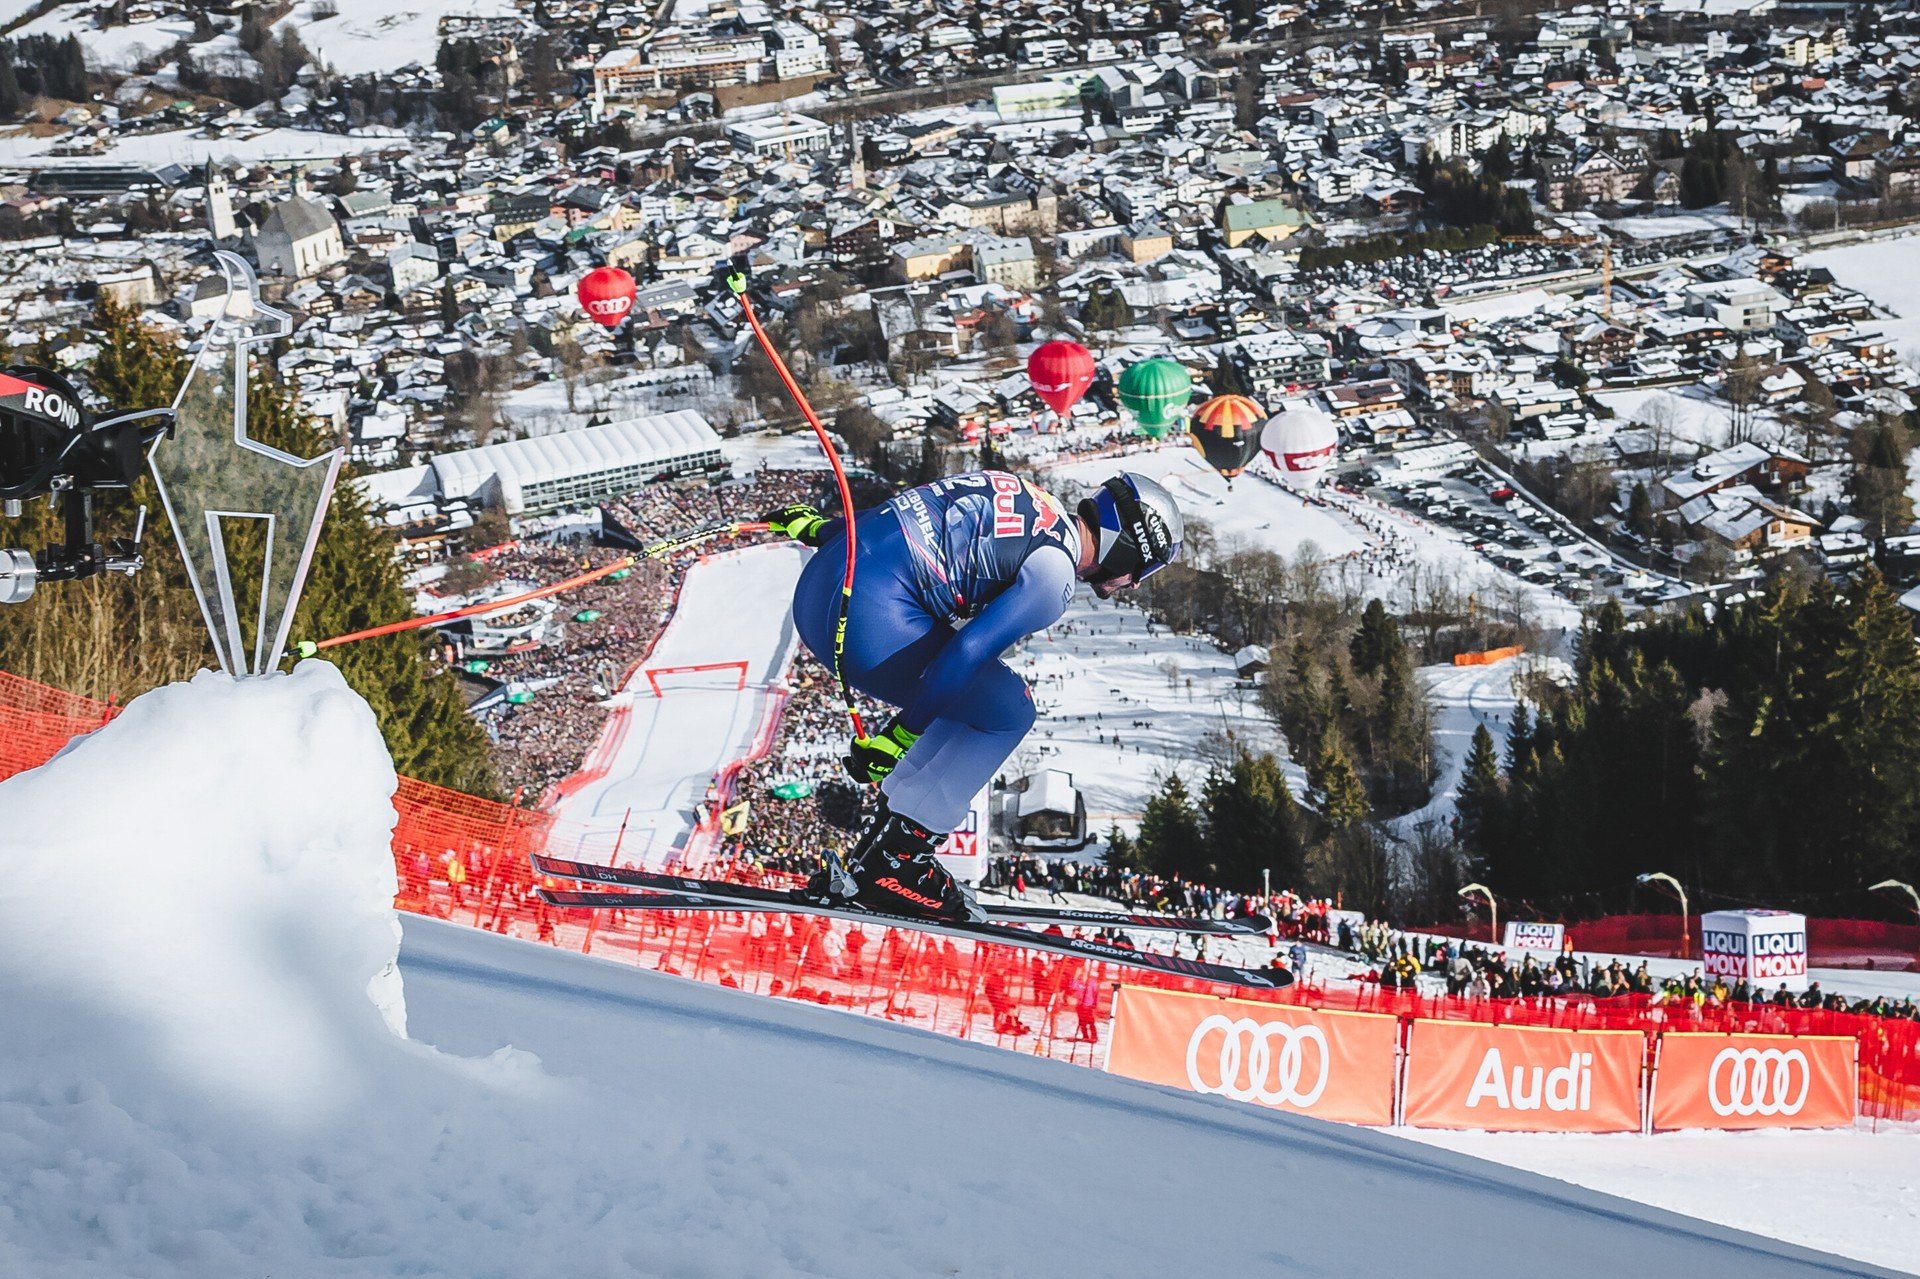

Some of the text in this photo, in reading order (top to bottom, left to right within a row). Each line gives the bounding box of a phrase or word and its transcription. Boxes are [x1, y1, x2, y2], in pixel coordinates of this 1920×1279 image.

[993, 475, 1025, 539] Bull
[1133, 521, 1153, 563] uvex
[1149, 515, 1168, 548] uvex
[875, 877, 944, 909] NORDICA
[1517, 925, 1553, 937] LIQUI
[1070, 939, 1144, 960] NORDICA
[1516, 936, 1553, 949] MOLY
[1703, 932, 1745, 954] LIQUI
[1754, 933, 1804, 955] LIQUI
[1704, 953, 1747, 975] MOLY
[1754, 954, 1806, 977] MOLY
[1465, 1047, 1592, 1112] Audi
